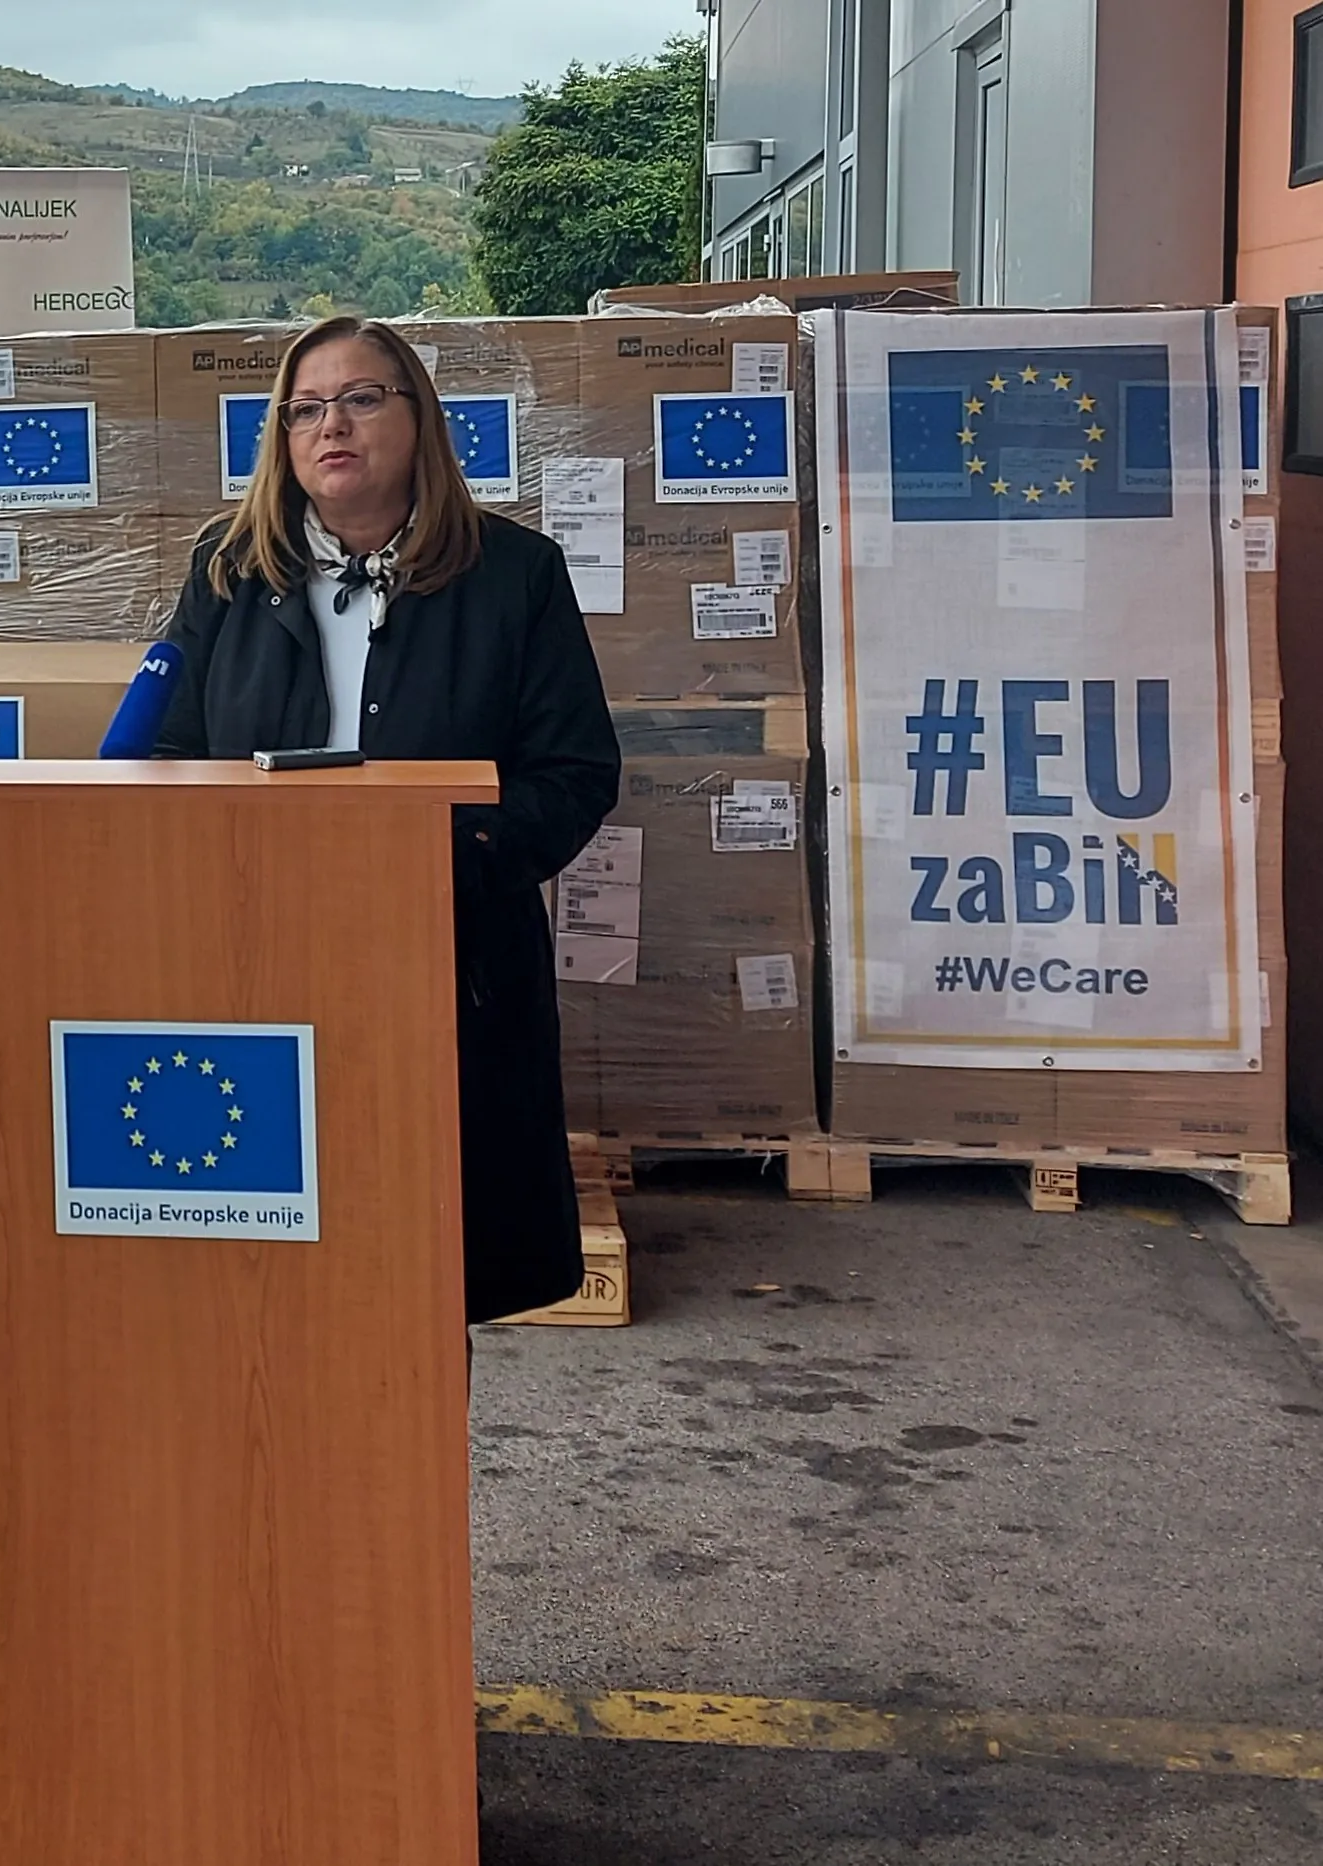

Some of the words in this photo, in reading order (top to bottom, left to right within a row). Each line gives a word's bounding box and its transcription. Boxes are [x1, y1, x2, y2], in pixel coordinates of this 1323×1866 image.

[645, 337, 724, 357] medical
[20, 490, 66, 503] Evropske
[67, 490, 91, 501] unije
[663, 486, 708, 497] Donacija
[711, 485, 760, 498] Evropske
[762, 484, 789, 496] unije
[905, 679, 1172, 820] #EU
[910, 832, 1178, 925] zaBiH
[936, 956, 1149, 995] #WeCare
[70, 1202, 152, 1225] Donacija
[159, 1204, 249, 1226] Evropske
[256, 1207, 304, 1228] unije
